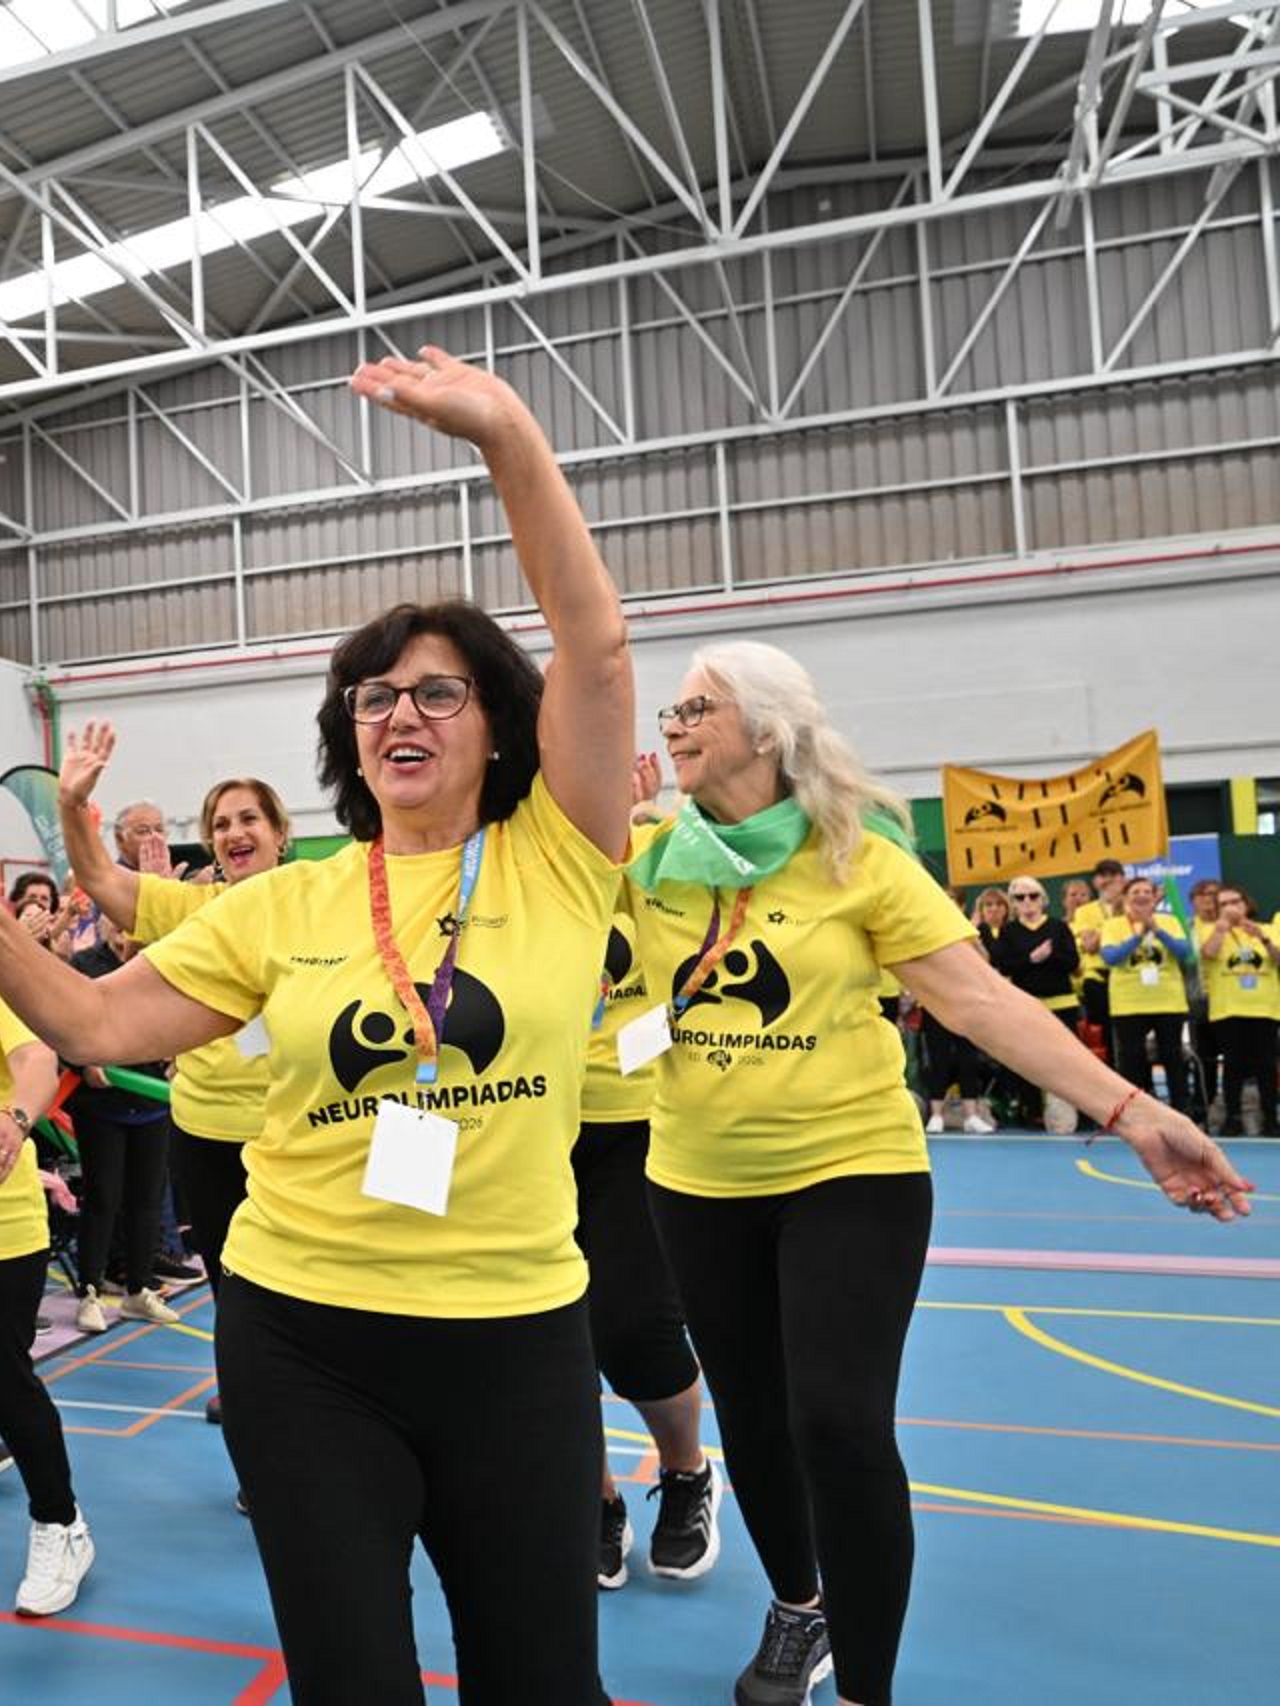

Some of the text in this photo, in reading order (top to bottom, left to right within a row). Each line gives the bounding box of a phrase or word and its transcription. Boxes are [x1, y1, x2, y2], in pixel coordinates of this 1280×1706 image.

[609, 985, 647, 1000] IADA
[671, 1028, 817, 1051] UROLIMPIADAS
[453, 1116, 483, 1132] 026
